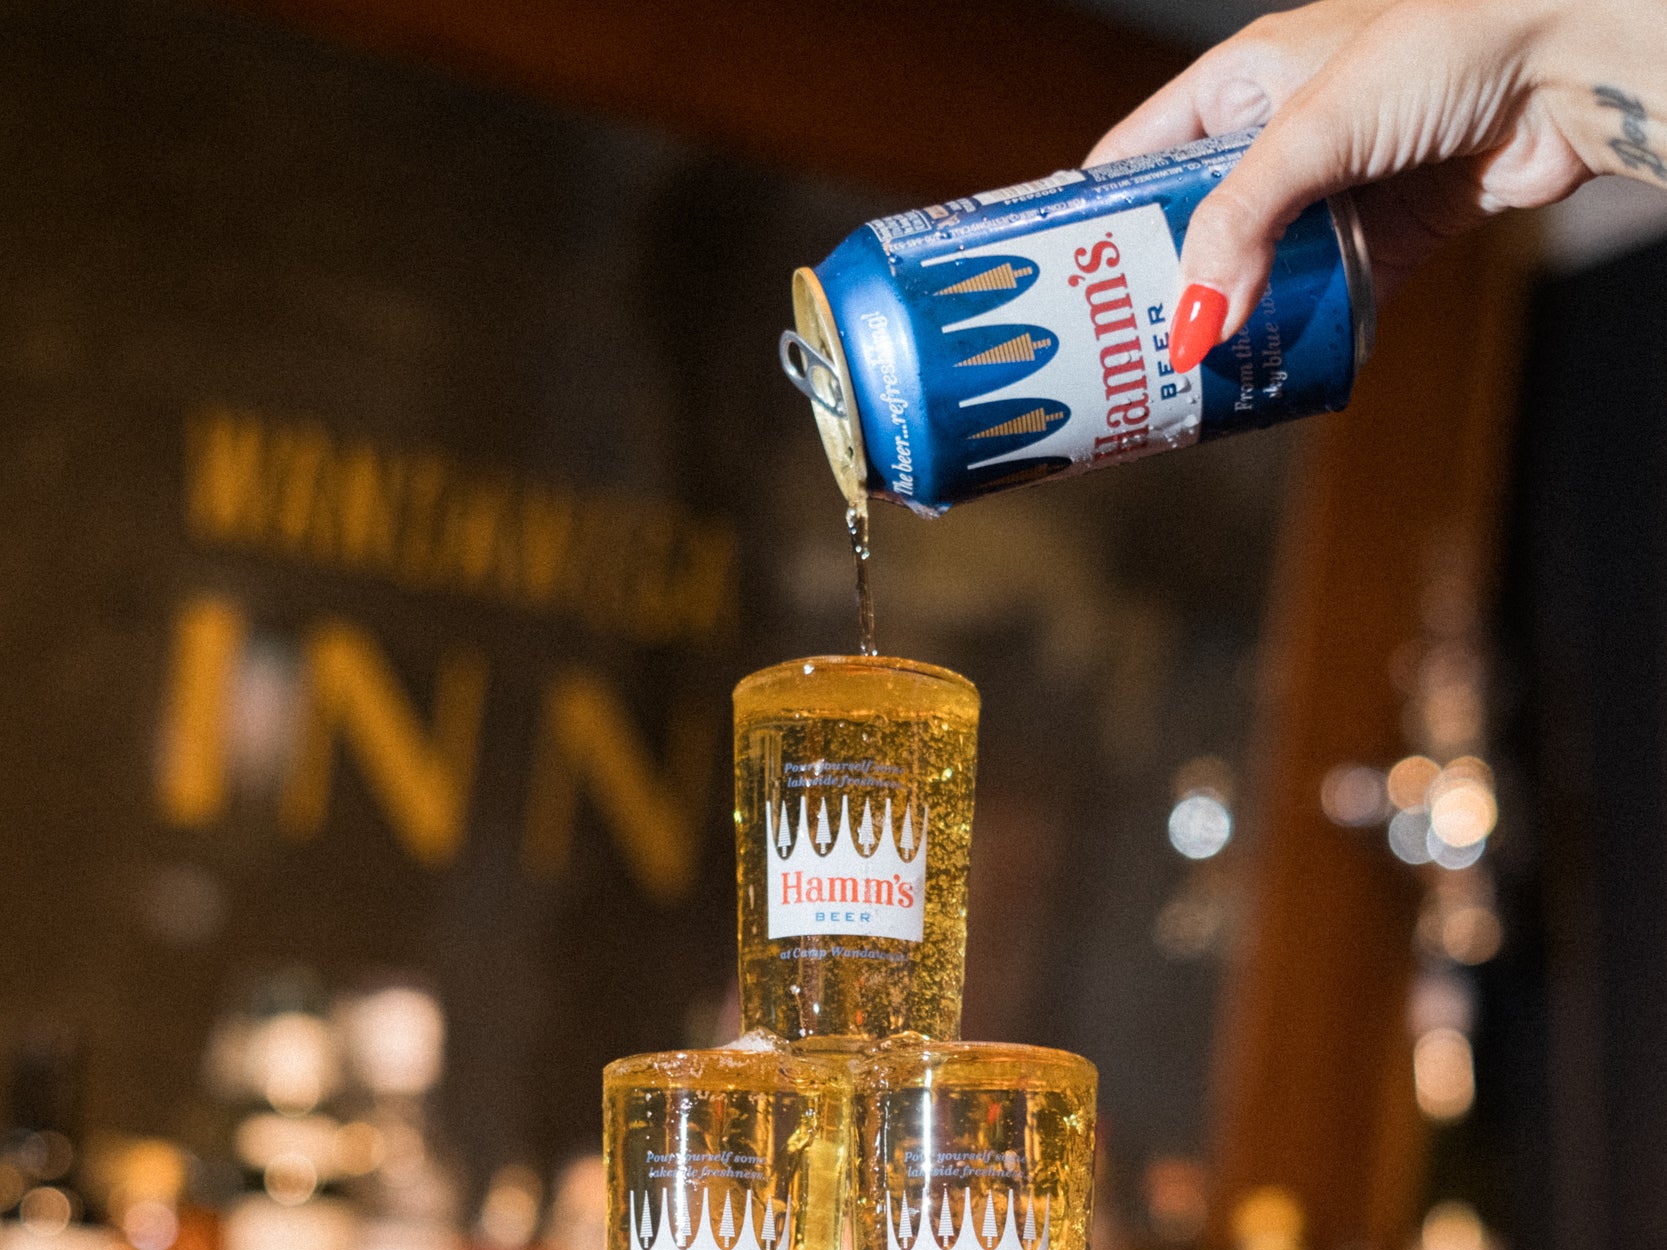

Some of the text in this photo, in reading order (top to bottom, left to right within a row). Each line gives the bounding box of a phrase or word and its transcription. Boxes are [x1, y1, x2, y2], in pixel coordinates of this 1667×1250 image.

[1148, 302, 1179, 400] BEER
[1262, 322, 1282, 368] blue
[1234, 361, 1254, 411] From
[892, 480, 913, 496] The
[782, 871, 914, 909] Hamm's
[815, 911, 872, 923] BEER
[780, 950, 790, 959] at
[793, 947, 827, 959] Camp
[646, 1151, 675, 1163] Pour
[734, 1154, 766, 1164] some
[936, 1150, 993, 1164] yourself
